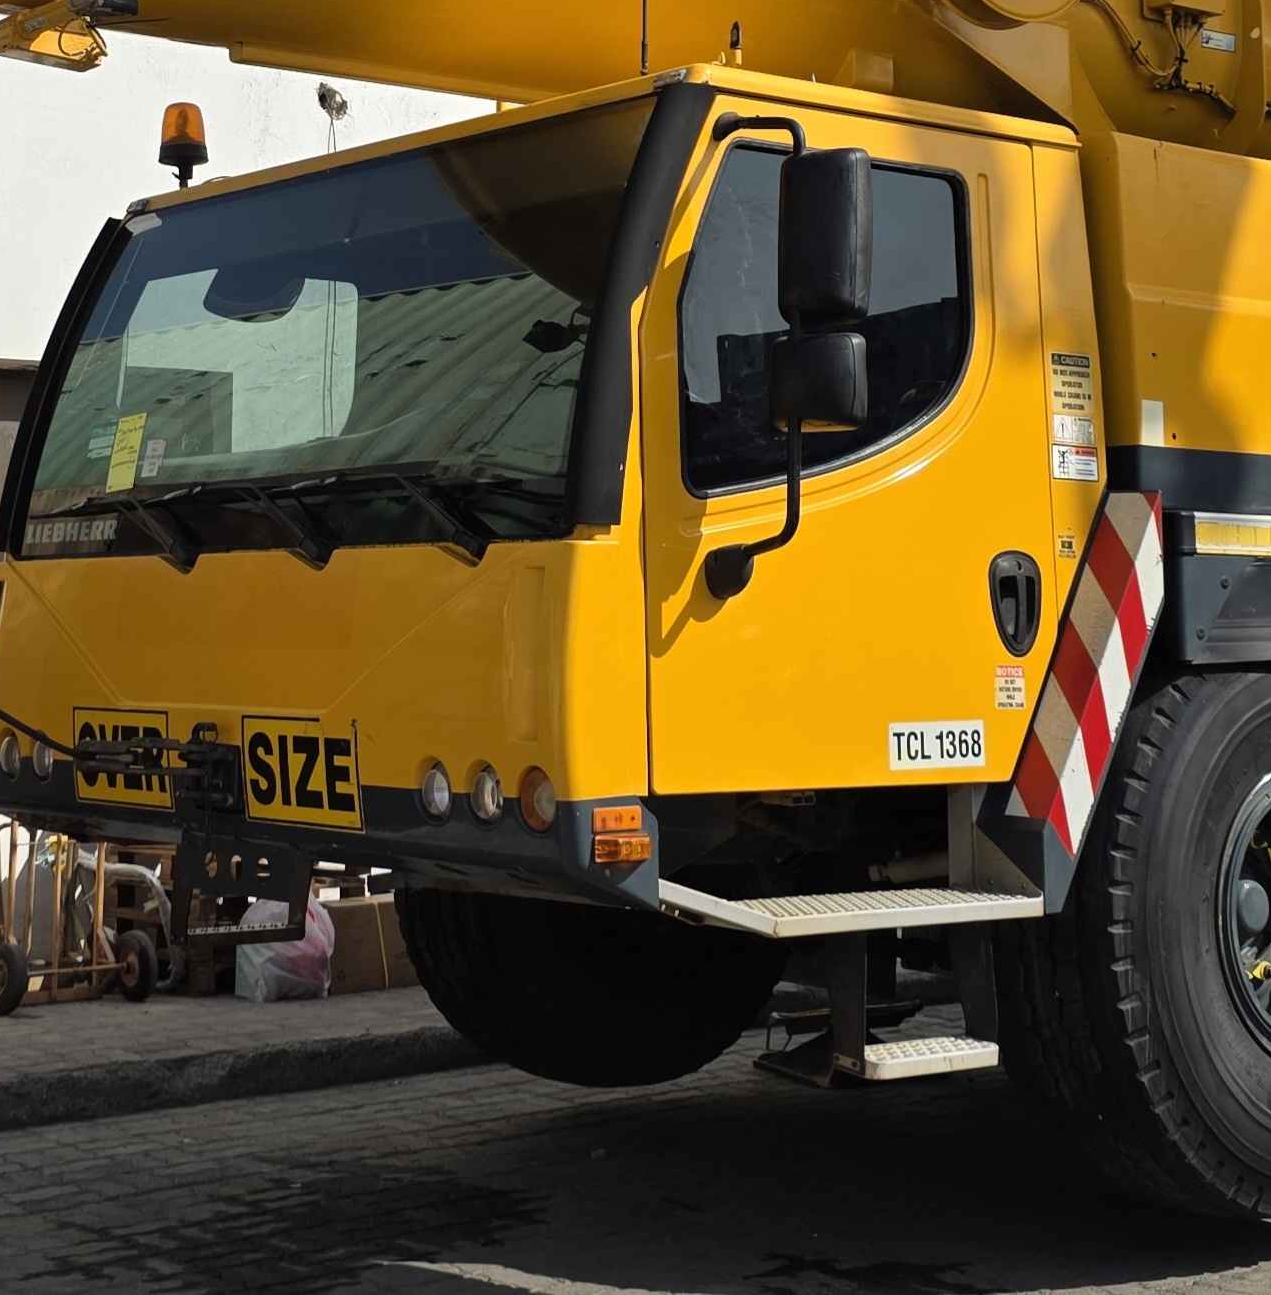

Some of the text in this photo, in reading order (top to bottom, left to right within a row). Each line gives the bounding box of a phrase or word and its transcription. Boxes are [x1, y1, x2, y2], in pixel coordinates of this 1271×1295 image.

[26, 519, 118, 543] LIEBHERR
[892, 728, 983, 761] TCL 1368
[248, 731, 357, 813] SIZE
